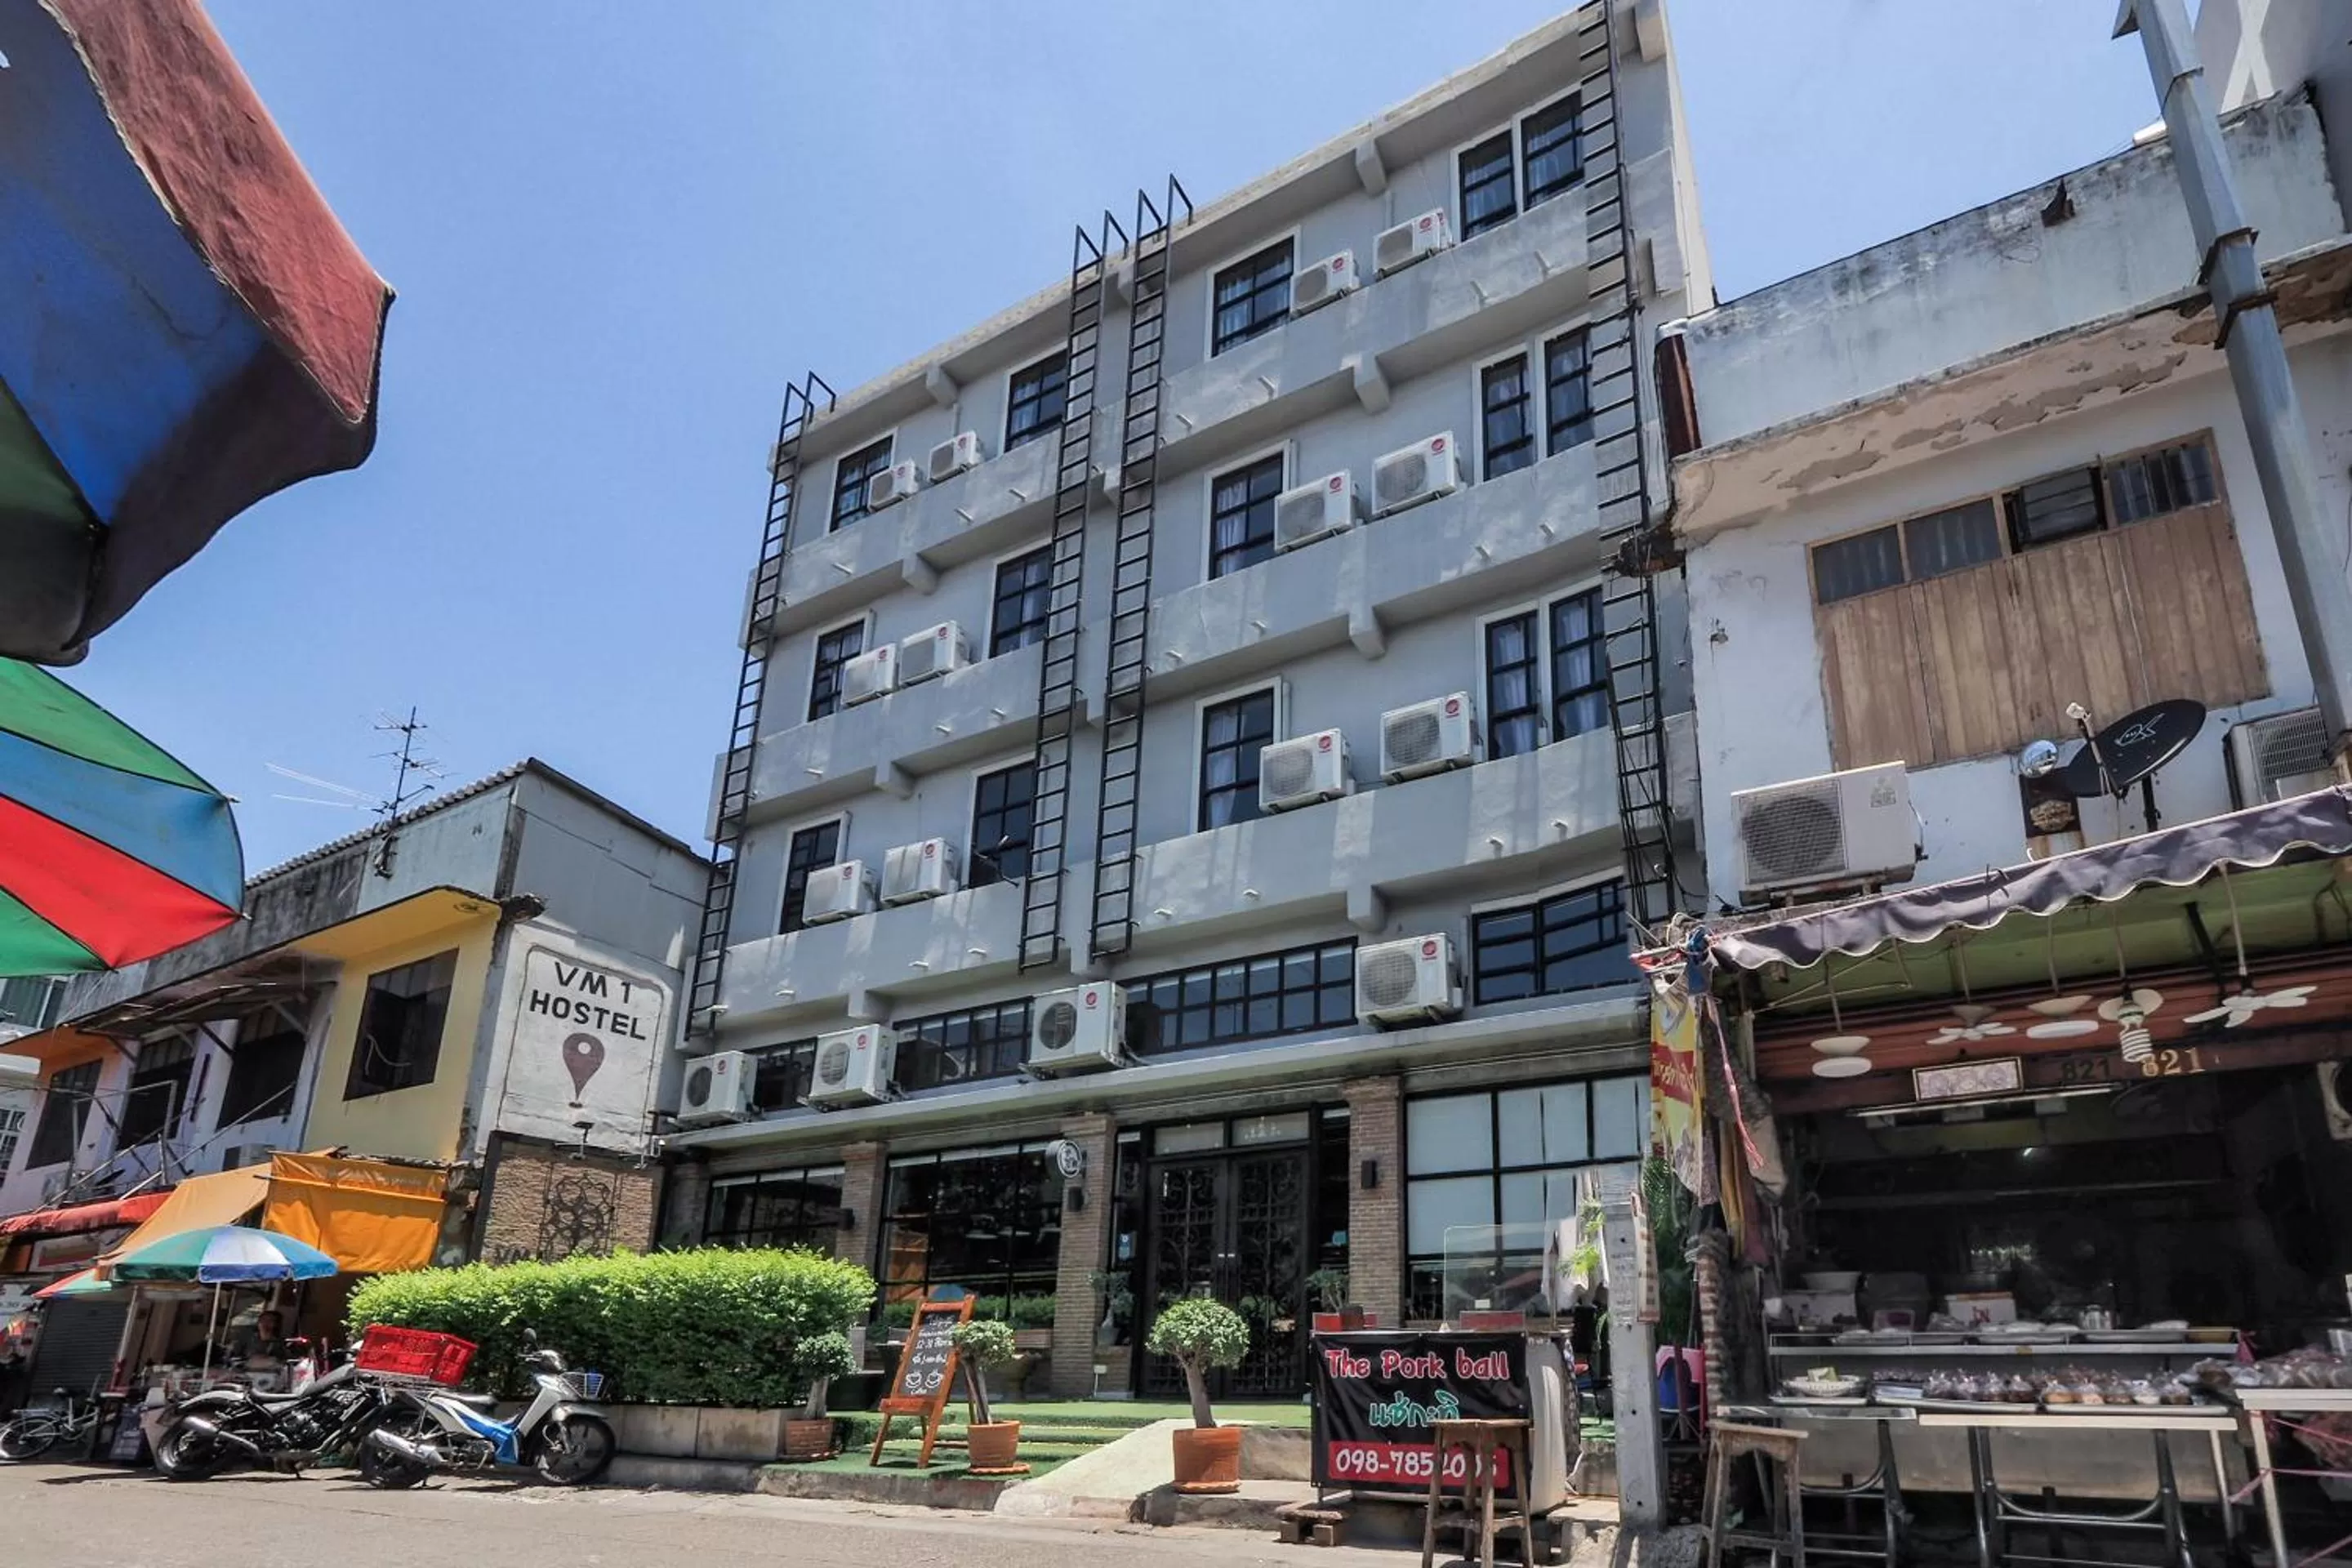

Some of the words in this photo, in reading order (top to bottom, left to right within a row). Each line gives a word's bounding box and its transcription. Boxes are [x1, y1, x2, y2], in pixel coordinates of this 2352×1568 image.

[529, 989, 647, 1041] HOSTEL
[2063, 1057, 2111, 1080] 821
[1325, 1348, 1370, 1379] The
[1380, 1349, 1447, 1379] Pork
[1456, 1348, 1510, 1380] ball
